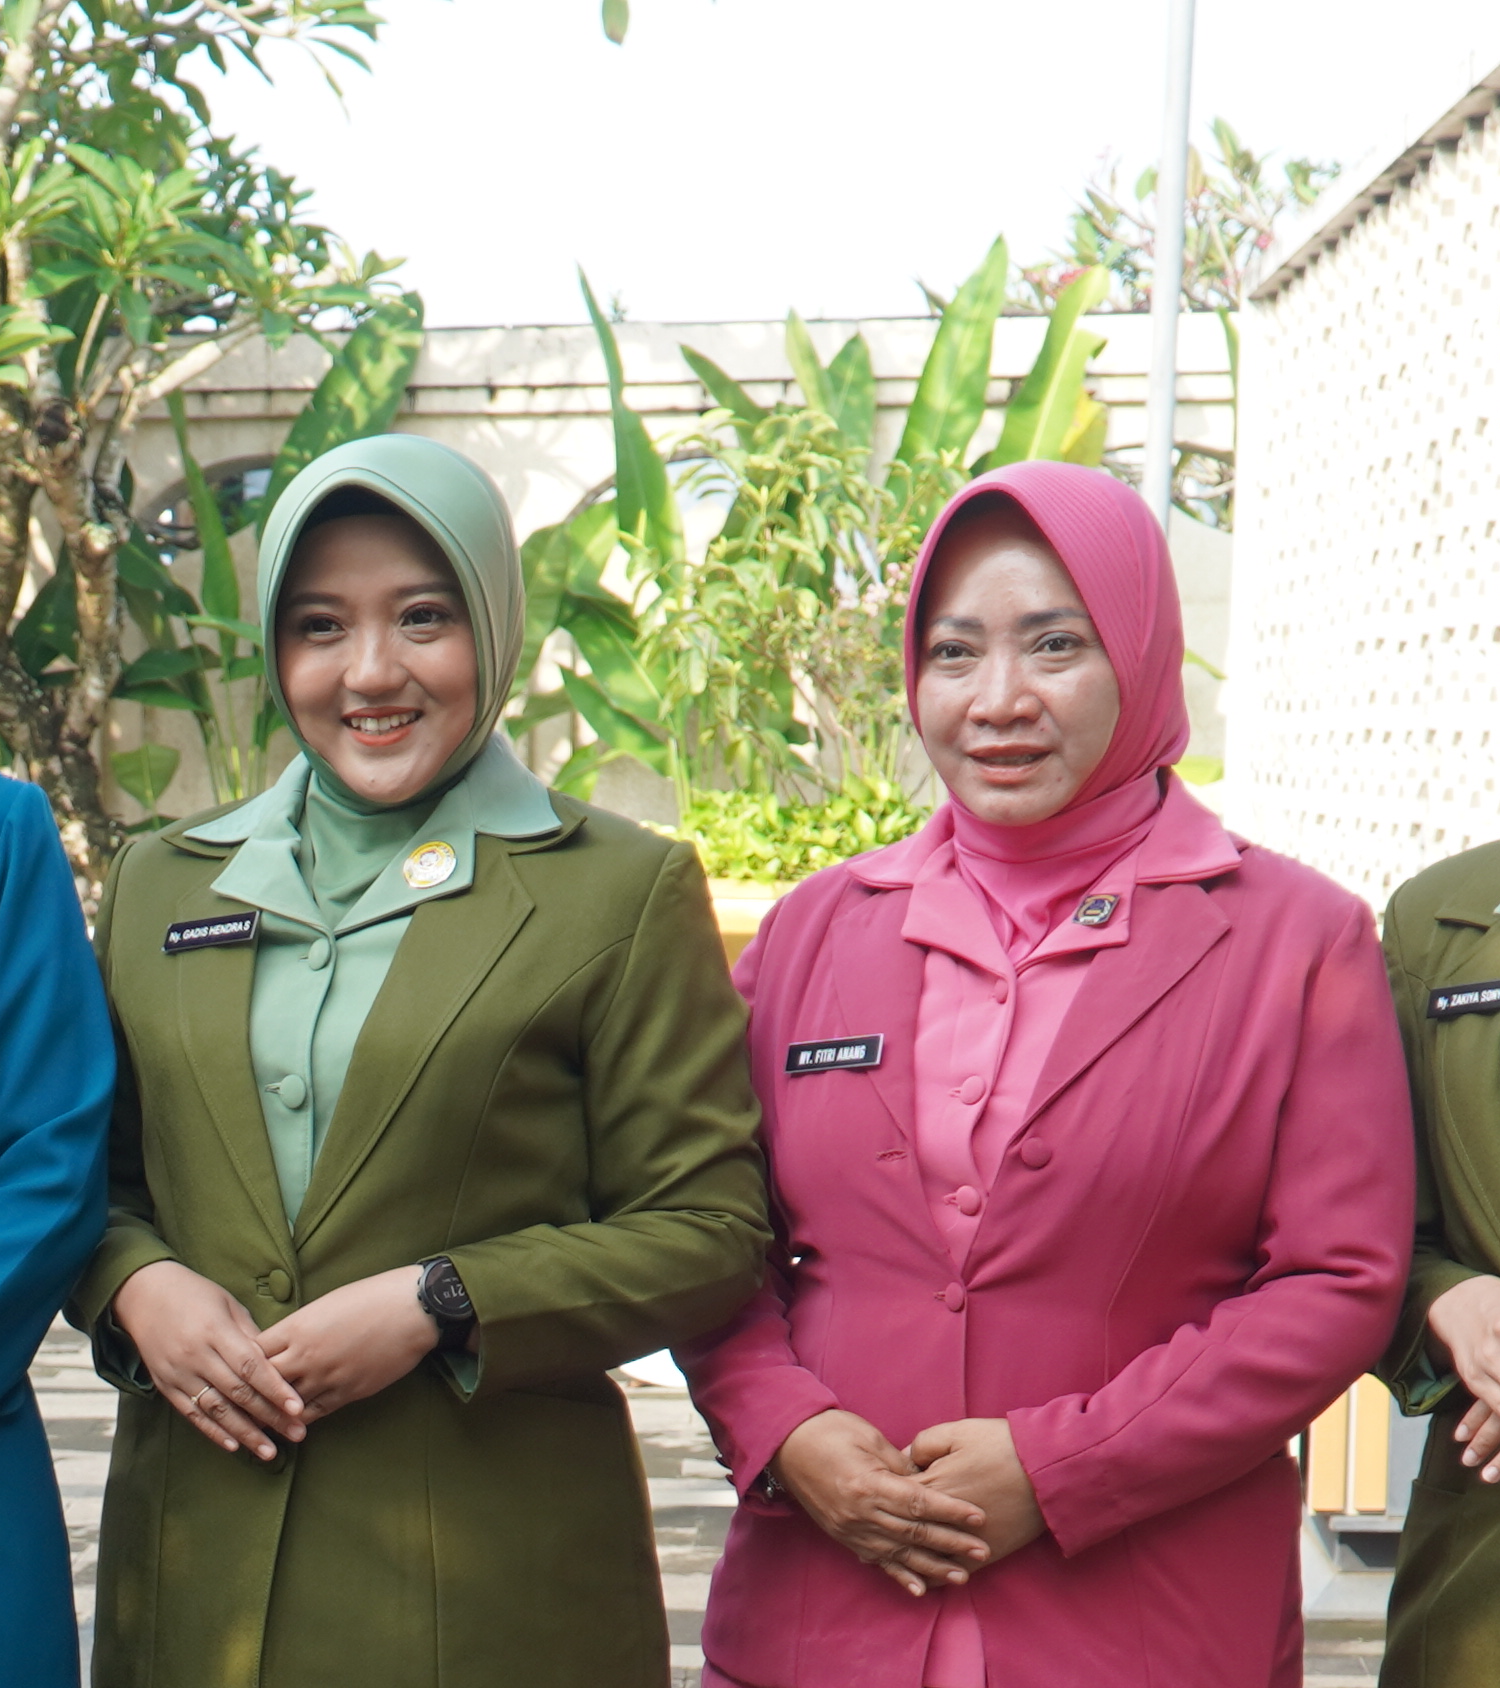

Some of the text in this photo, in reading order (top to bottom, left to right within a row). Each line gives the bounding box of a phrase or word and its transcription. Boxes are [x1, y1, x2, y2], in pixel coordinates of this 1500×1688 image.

[182, 926, 209, 940] GADIS
[209, 922, 243, 936] HENDRA
[243, 920, 252, 931] S
[814, 1047, 837, 1064] FITRI
